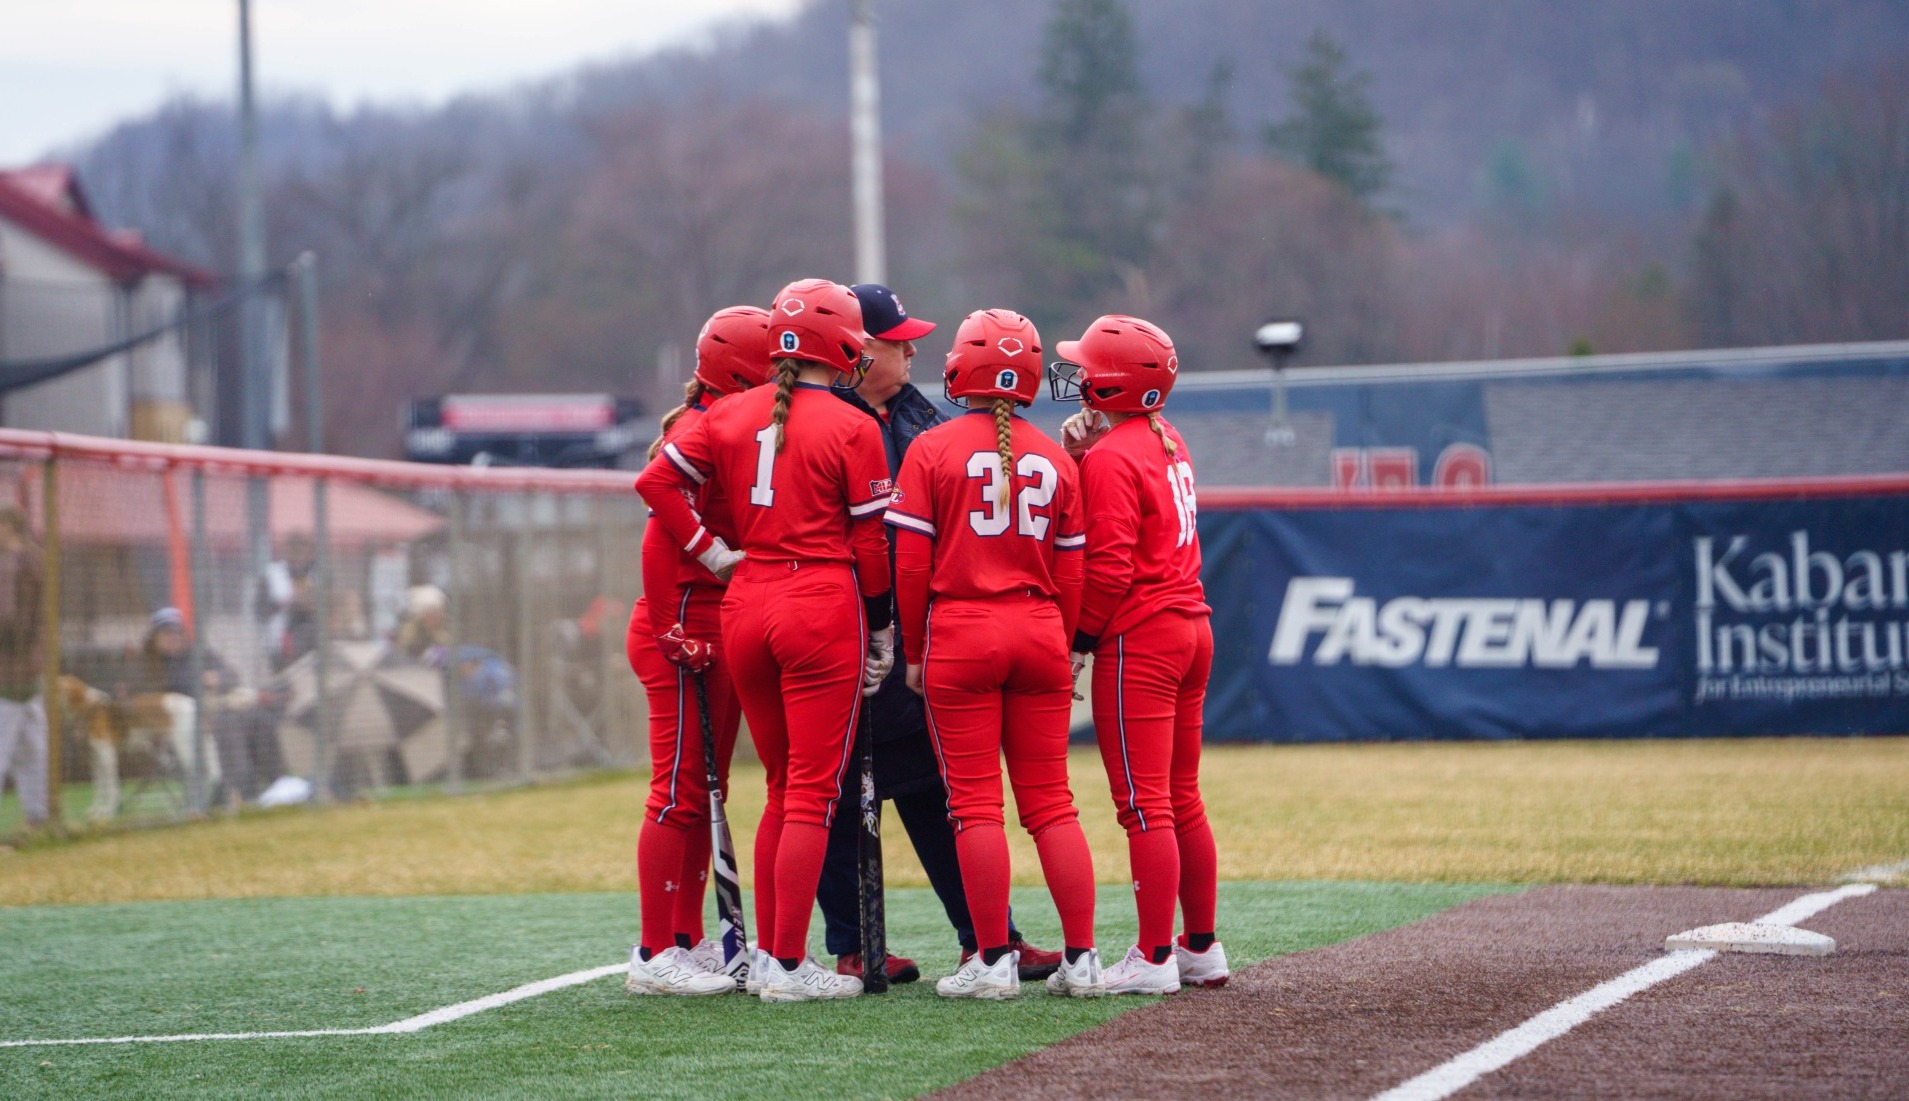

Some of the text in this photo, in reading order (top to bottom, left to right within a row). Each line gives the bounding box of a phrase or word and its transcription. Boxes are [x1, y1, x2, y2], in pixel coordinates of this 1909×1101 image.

[750, 422, 782, 508] 1
[965, 451, 1058, 542] 32
[1268, 577, 1661, 668] FASTENAL
[1695, 608, 1909, 674] Institu
